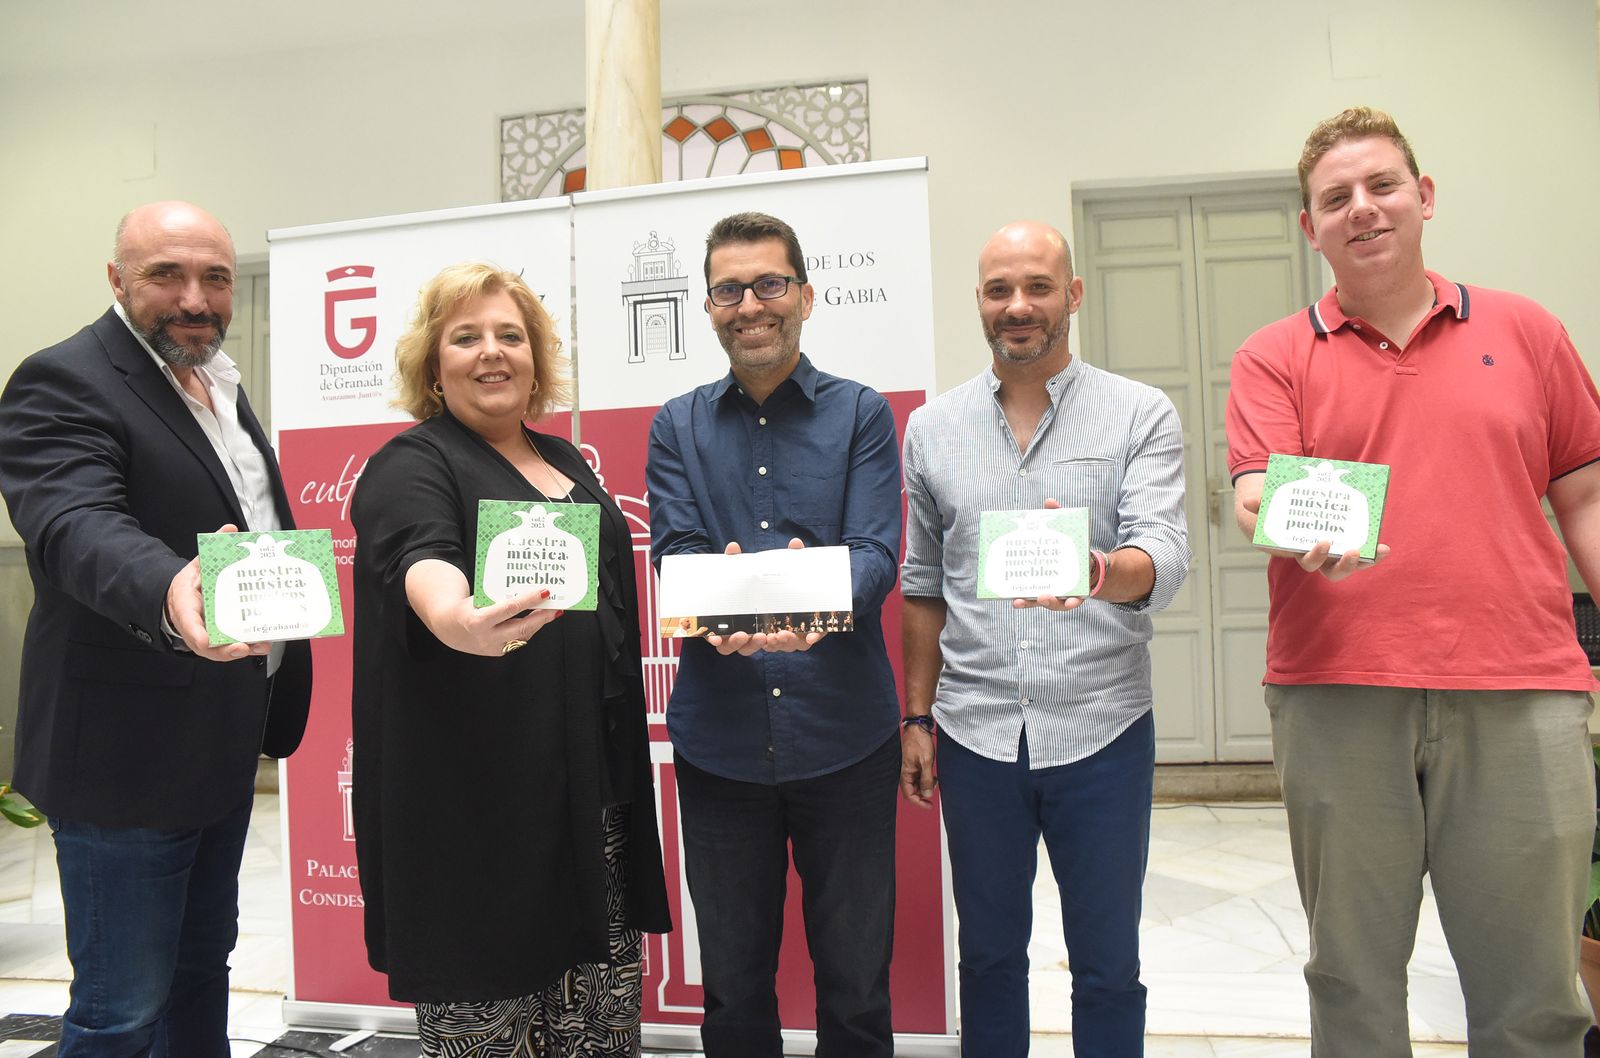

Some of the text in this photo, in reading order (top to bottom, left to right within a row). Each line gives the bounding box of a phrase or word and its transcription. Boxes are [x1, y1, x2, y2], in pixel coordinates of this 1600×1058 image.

[806, 251, 876, 271] DE LOS
[824, 286, 887, 306] GABIA
[319, 360, 383, 378] Diputación
[319, 374, 383, 391] de Granada
[1292, 487, 1350, 501] nuestra
[1288, 508, 1347, 521] nuestros
[1286, 519, 1345, 533] pueblos
[1005, 537, 1059, 546] nuestra
[506, 561, 566, 571] nuestros
[1005, 557, 1059, 567] nuestros
[236, 566, 302, 578] nuestra
[1005, 566, 1059, 581] pueblos
[506, 572, 566, 587] pueblos
[299, 888, 365, 908] CONDES
